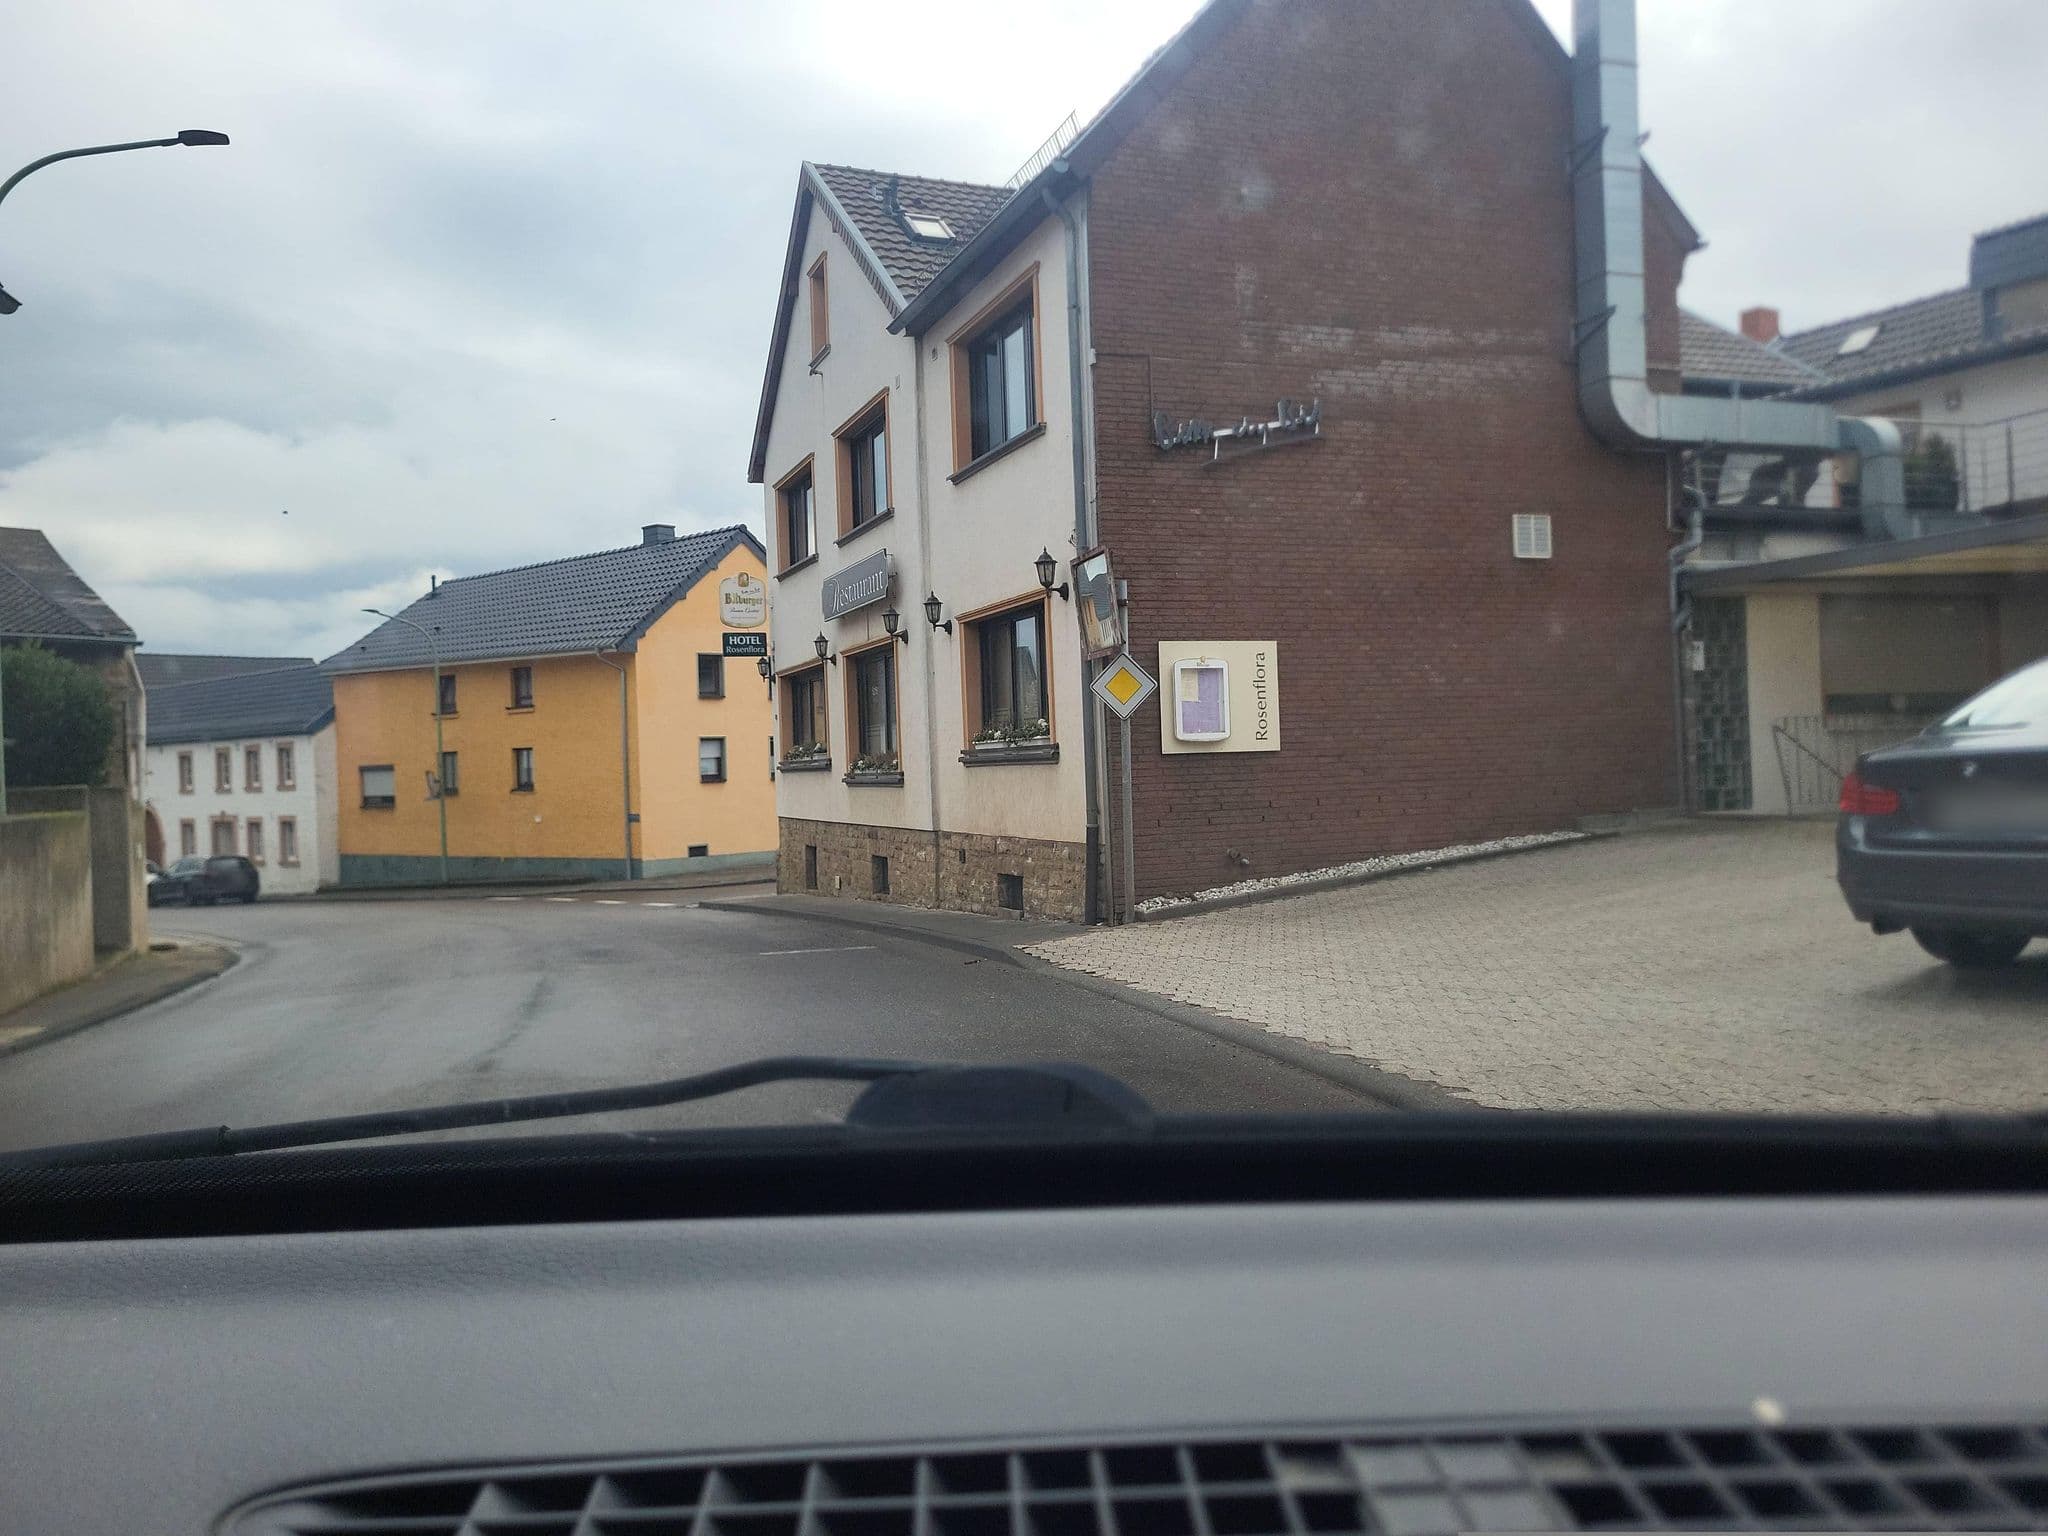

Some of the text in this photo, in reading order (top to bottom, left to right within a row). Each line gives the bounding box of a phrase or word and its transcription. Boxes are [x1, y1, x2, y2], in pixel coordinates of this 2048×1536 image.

[829, 571, 884, 614] Restaurant
[726, 645, 765, 654] Rosenflora
[729, 636, 762, 645] HOTEL
[1253, 652, 1268, 741] Rosenflora
